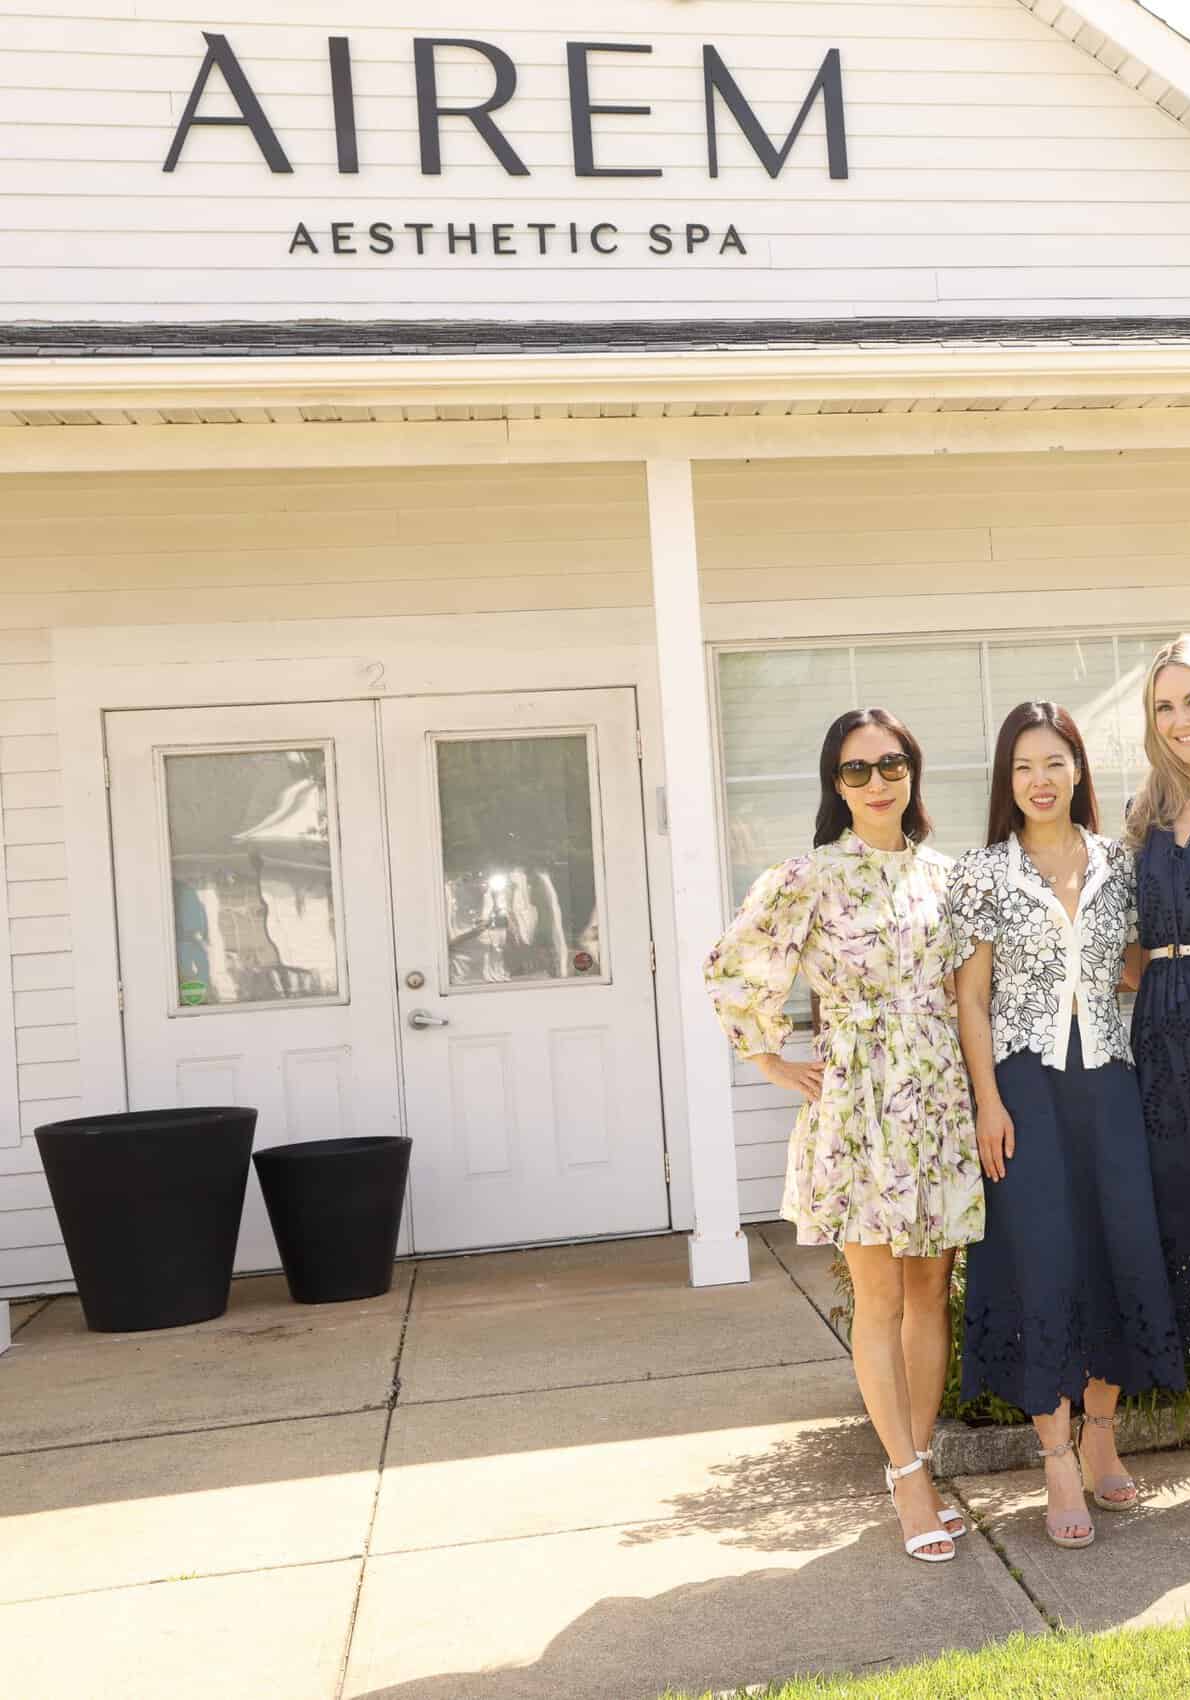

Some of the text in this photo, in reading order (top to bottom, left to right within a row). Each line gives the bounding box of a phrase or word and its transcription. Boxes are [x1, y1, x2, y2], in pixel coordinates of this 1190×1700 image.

[162, 31, 850, 181] AIREM
[288, 222, 748, 256] AESTHETIC SPA
